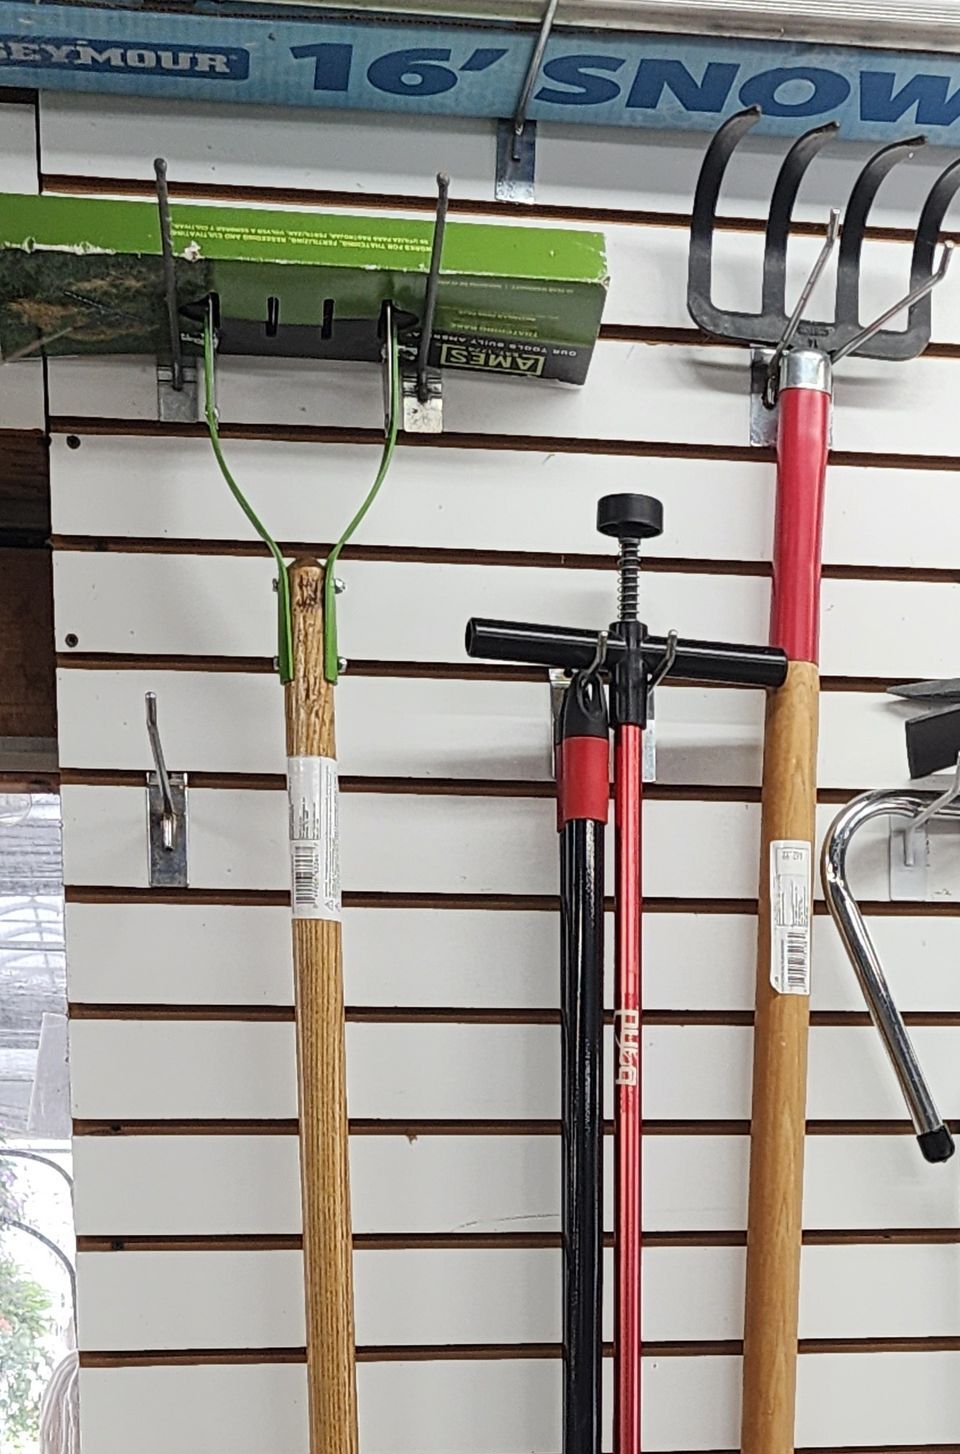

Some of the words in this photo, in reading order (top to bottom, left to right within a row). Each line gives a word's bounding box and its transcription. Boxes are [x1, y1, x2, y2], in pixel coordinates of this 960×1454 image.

[0, 36, 231, 74] EYMOUR
[470, 338, 505, 348] BUILT
[509, 343, 547, 353] TOOLS
[552, 348, 577, 356] OUR
[448, 349, 535, 371] AMES
